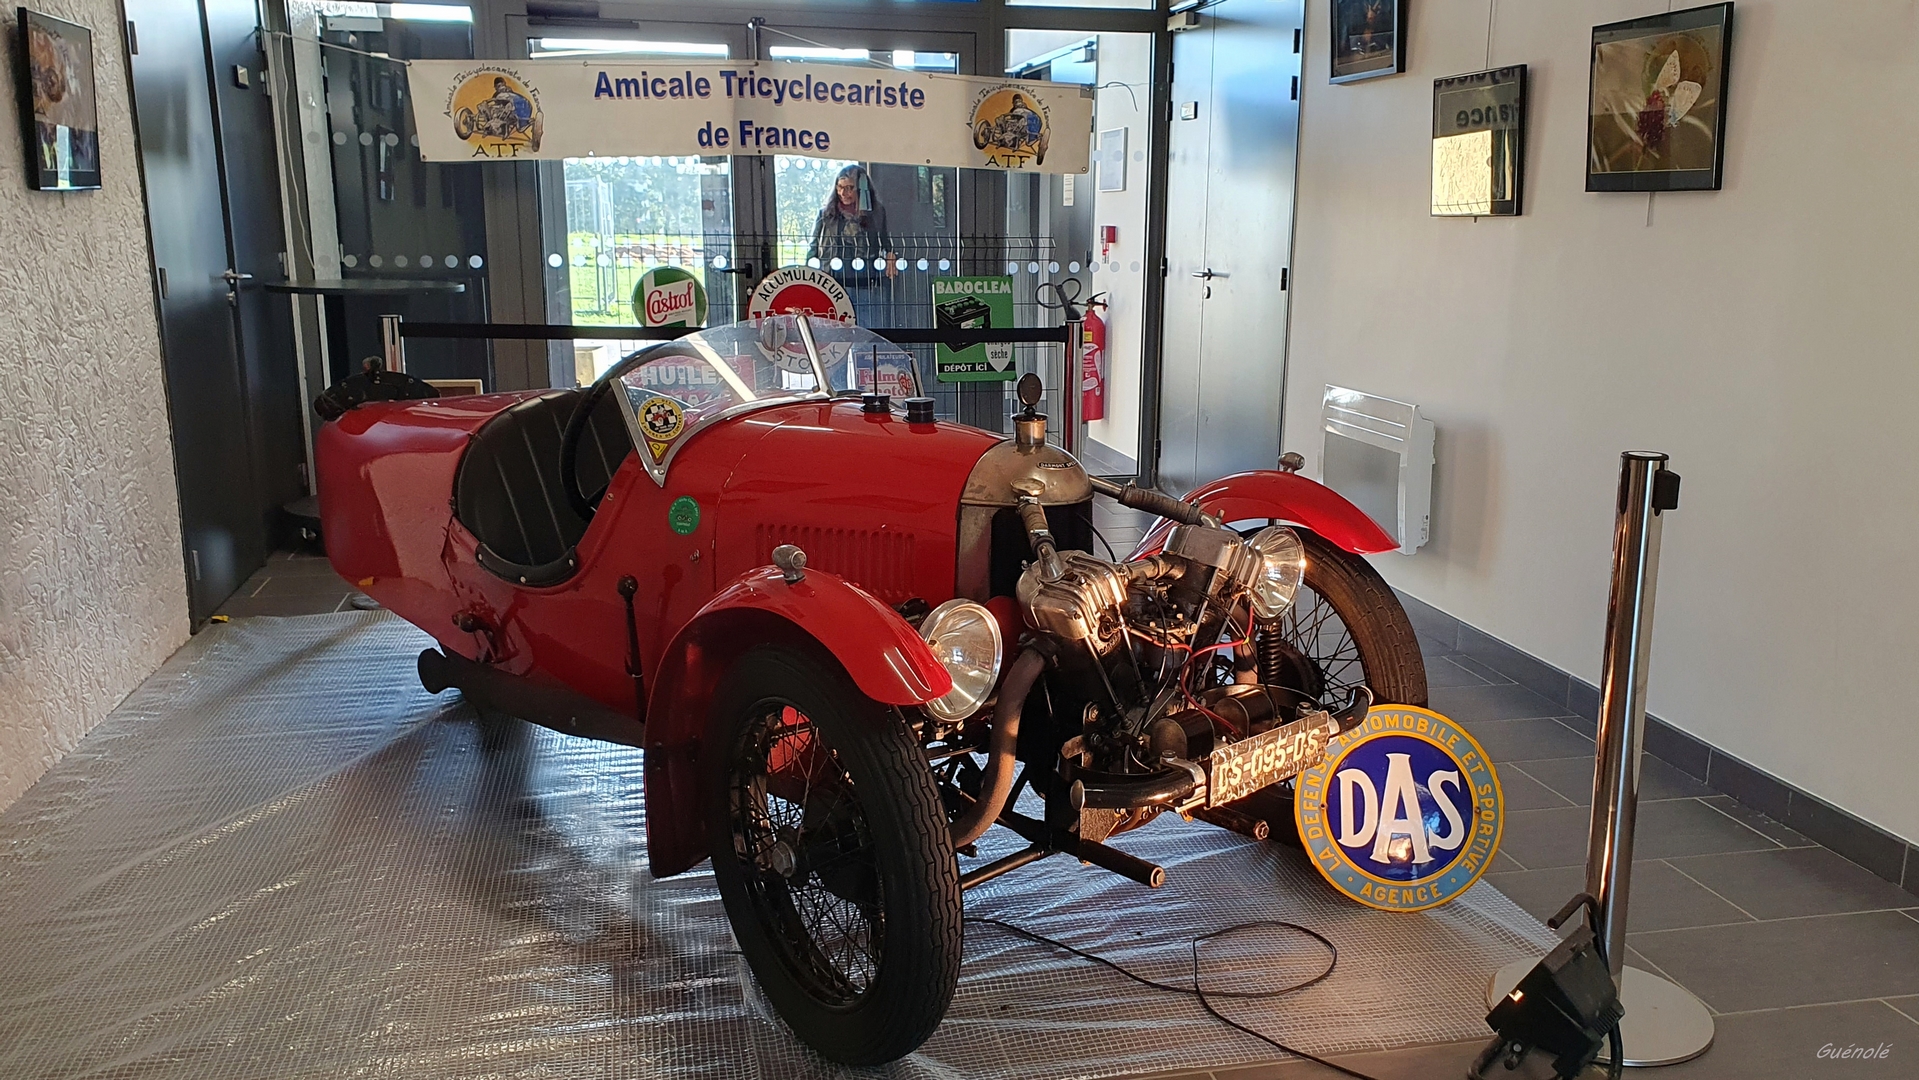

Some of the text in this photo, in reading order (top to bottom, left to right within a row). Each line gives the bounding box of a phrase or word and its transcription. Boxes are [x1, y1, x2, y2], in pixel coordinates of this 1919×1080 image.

[594, 69, 926, 108] Amicale Tricyclecariste
[697, 119, 831, 150] de France
[758, 269, 844, 302] ACCUMULATEUR
[936, 281, 1012, 294] BAROCLEM
[646, 281, 694, 325] Castrol
[944, 362, 973, 372] DÉPÔT
[991, 347, 1008, 359] sèche
[639, 366, 717, 386] HUILE
[1217, 728, 1320, 797] DS-095-DS
[1302, 713, 1495, 874] LA DEFENSE AUTOMOBILE ET SPORTIVE
[1336, 752, 1464, 865] DAS
[1359, 883, 1443, 905] AGENCE
